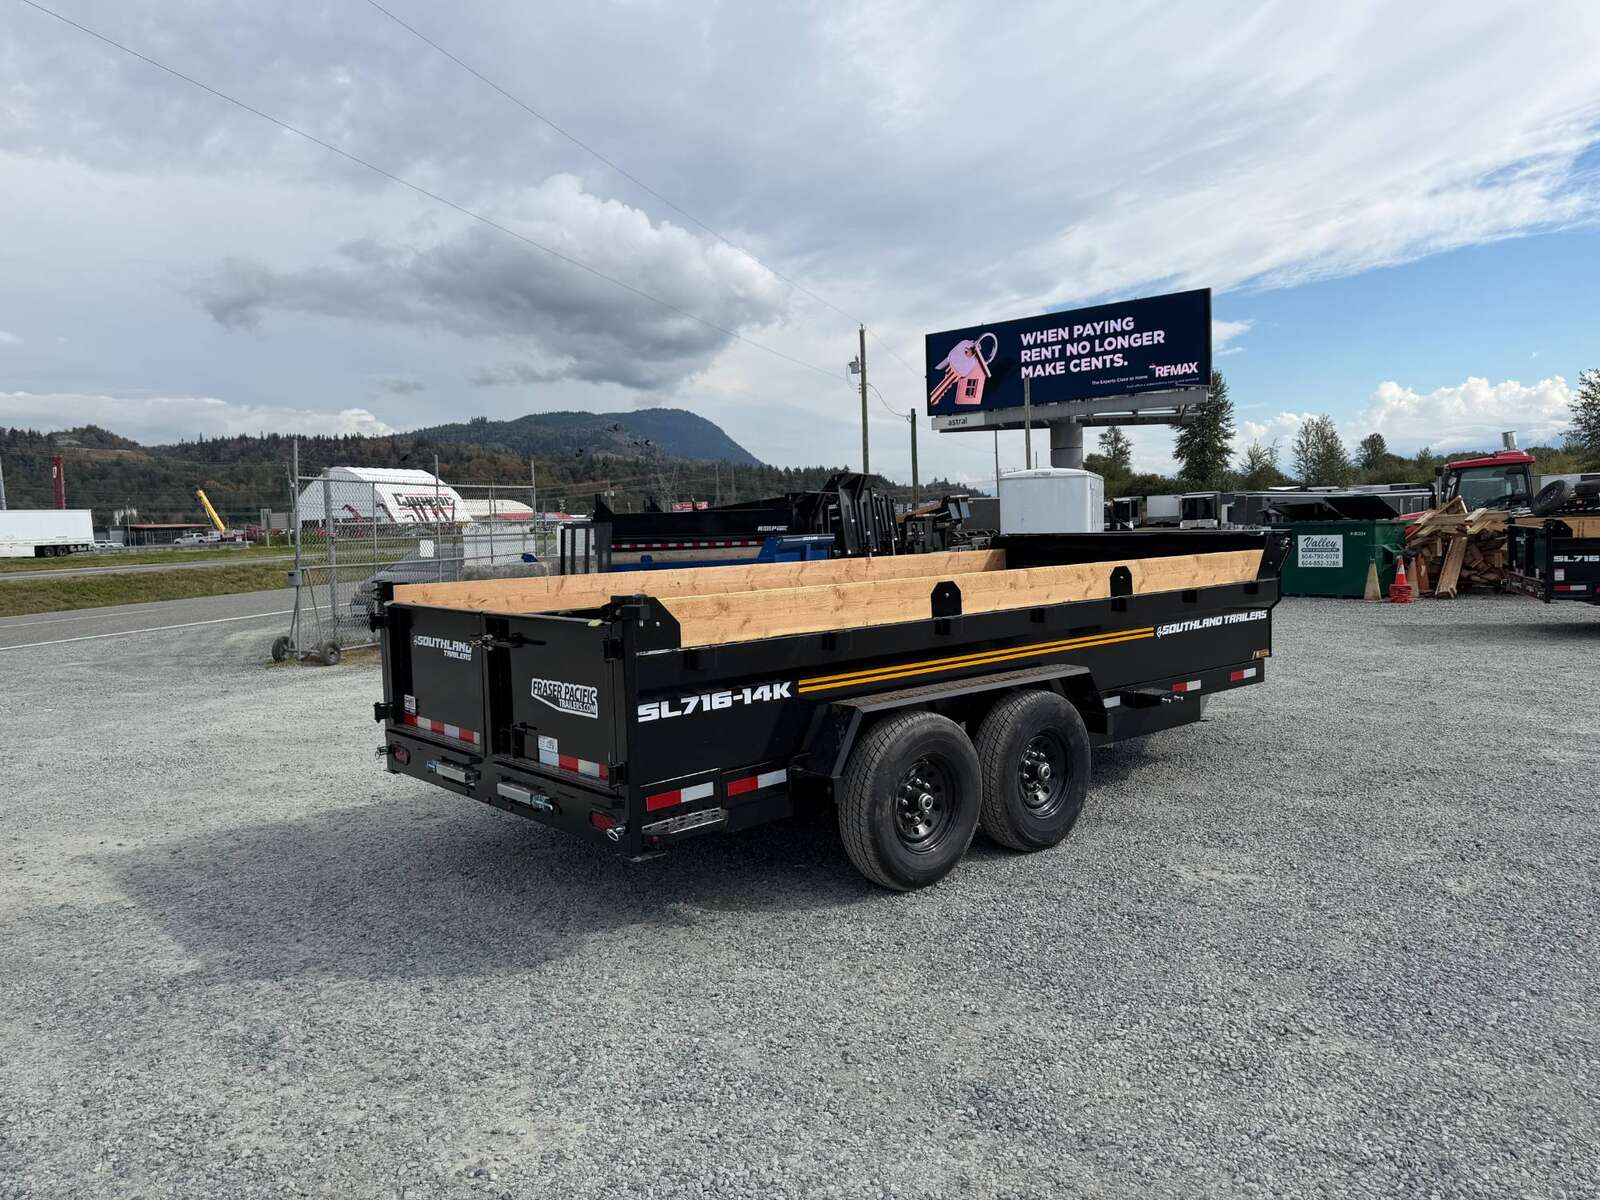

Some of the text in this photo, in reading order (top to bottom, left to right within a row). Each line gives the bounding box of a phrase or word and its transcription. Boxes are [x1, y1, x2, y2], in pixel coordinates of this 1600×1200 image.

[1021, 316, 1134, 346] WHEN PAYING
[1021, 330, 1165, 363] RENT NO LONGER
[1021, 353, 1128, 379] MAKE CENTS.
[948, 416, 968, 426] astral
[1304, 536, 1336, 548] Valley
[1161, 609, 1268, 635] SOUTHLAND TRAILERS
[417, 635, 472, 654] SOUTHLAND
[443, 649, 472, 661] TRAILERS
[533, 681, 596, 704] FRASER PACIFIC
[637, 681, 792, 723] SL716-14K
[559, 698, 596, 713] TRAILERS.COM
